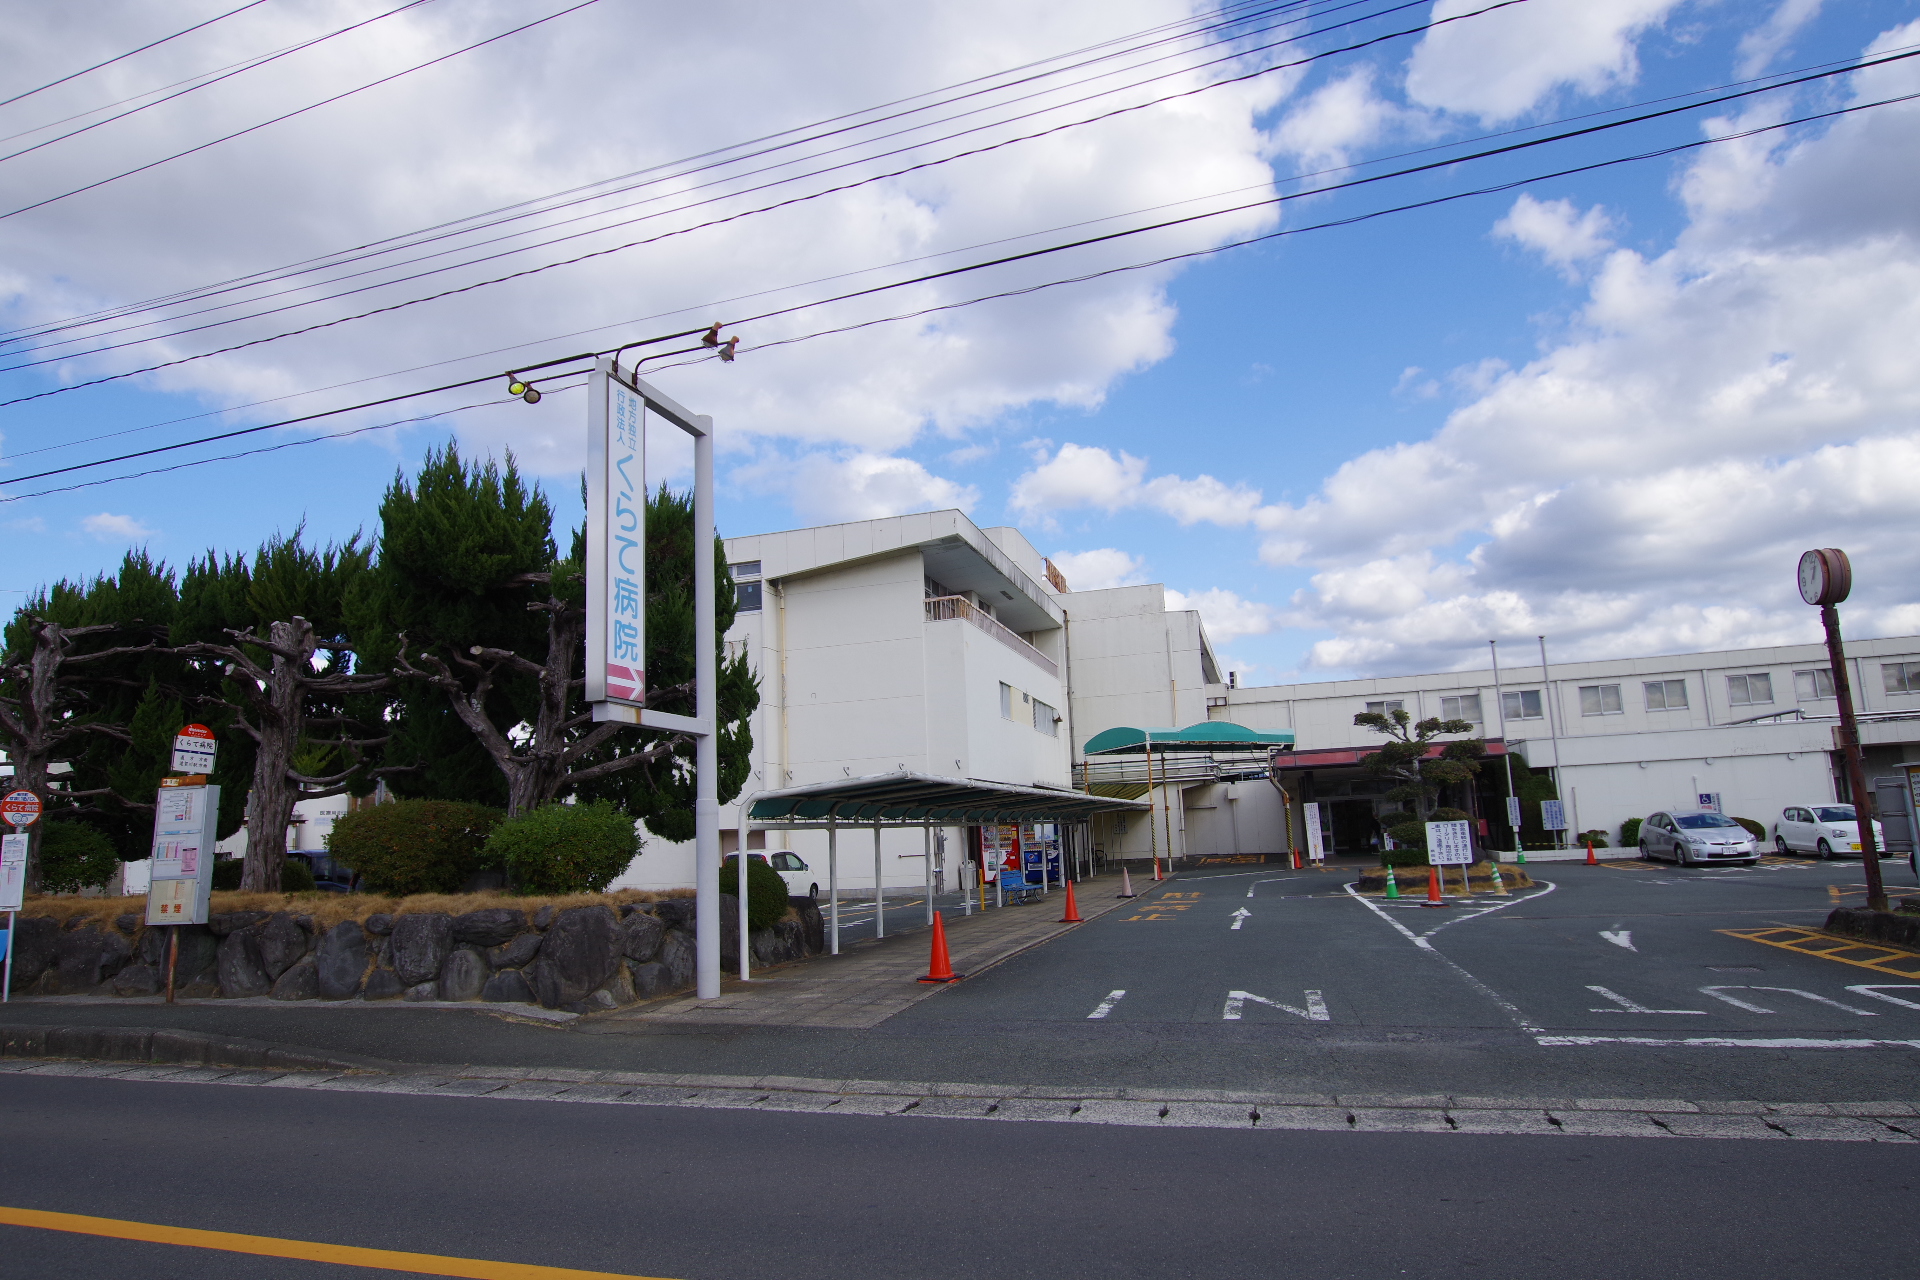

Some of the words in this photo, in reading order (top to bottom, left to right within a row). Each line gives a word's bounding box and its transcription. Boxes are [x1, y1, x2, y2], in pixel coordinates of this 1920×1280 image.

[616, 389, 626, 446] 行政法人
[615, 454, 639, 662] くらて病院
[179, 738, 214, 750] くらて病院
[5, 803, 39, 812] くらて病院
[160, 903, 182, 914] 禁煙
